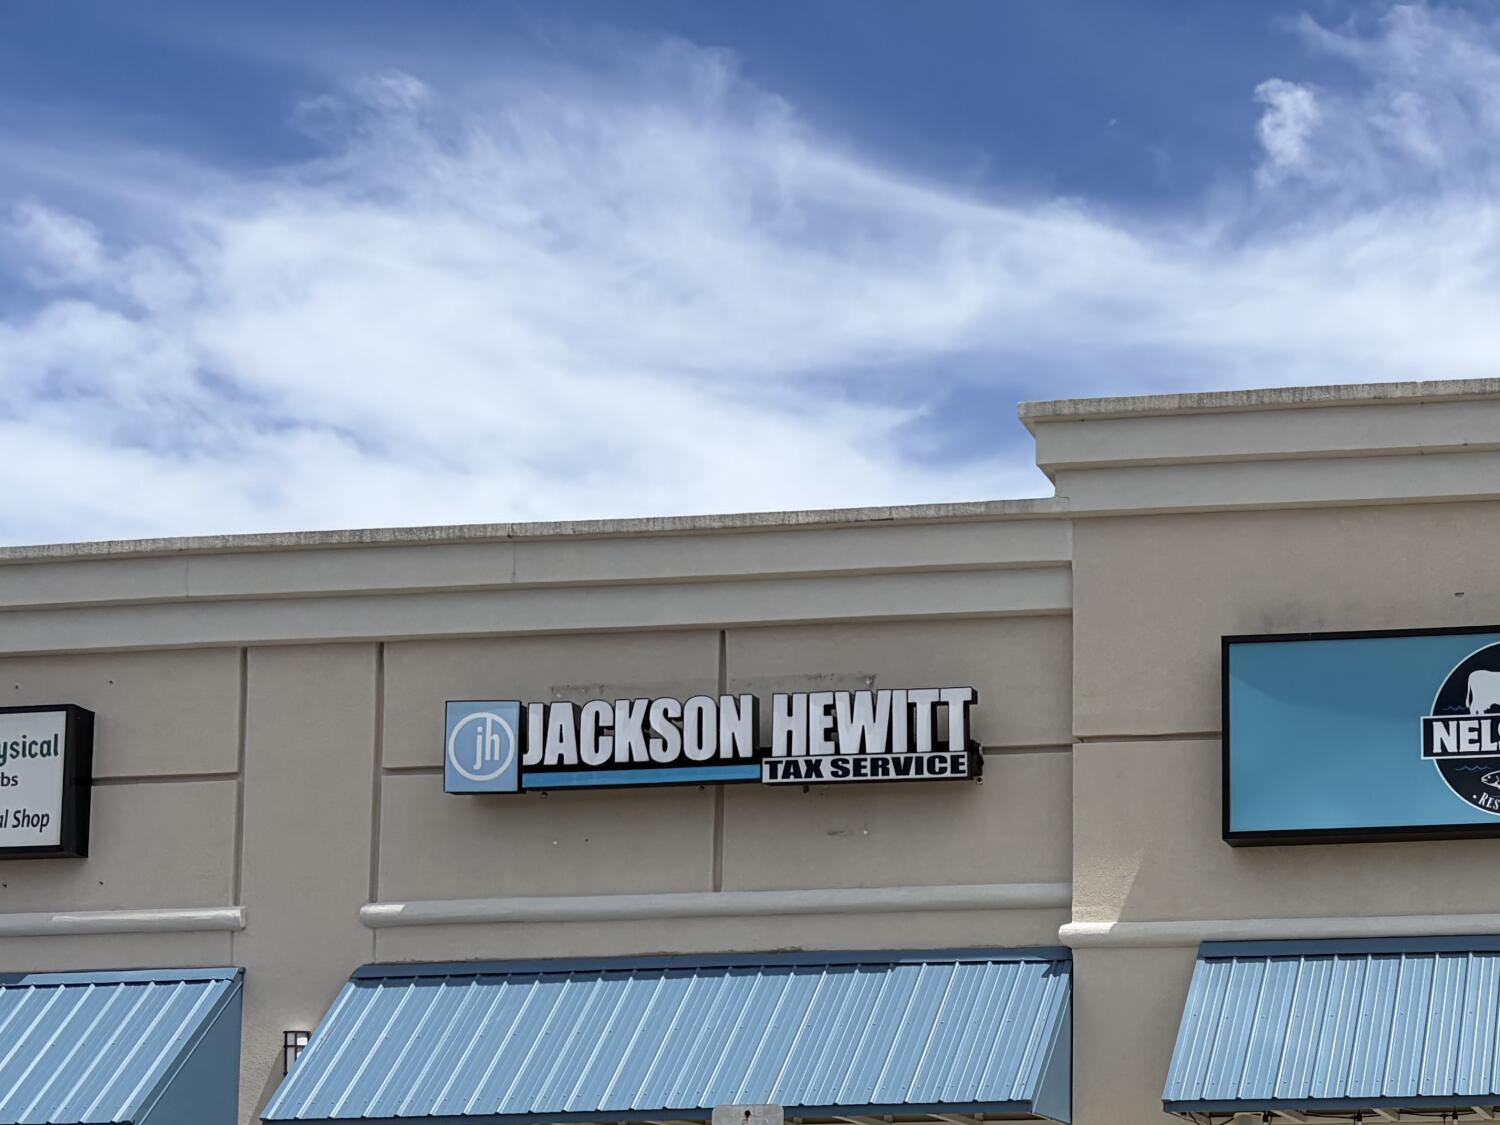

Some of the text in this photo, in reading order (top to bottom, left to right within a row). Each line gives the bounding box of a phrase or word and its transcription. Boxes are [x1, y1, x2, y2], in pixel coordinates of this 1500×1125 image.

[522, 687, 974, 766] JACKSON HEWITT
[764, 753, 967, 781] TAX SERVICE
[12, 808, 50, 832] Shop
